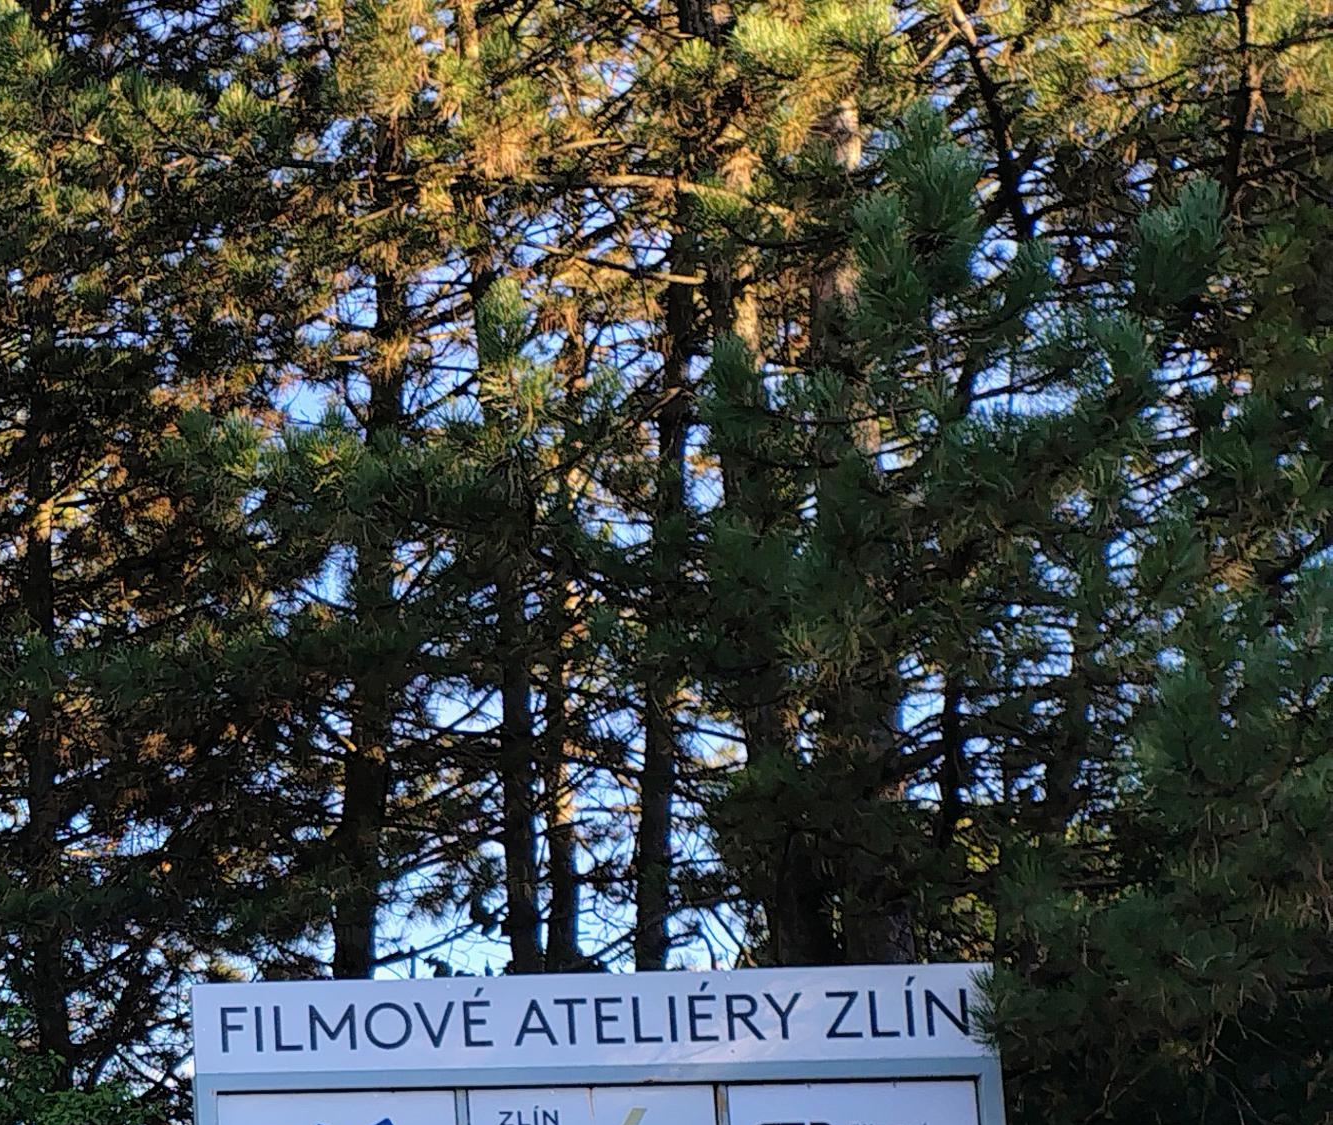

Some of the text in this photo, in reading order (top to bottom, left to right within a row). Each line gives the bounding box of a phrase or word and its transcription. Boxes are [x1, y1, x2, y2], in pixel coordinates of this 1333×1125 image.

[221, 976, 971, 1053] FILMOVÉ ATELIÉRY ZLÍN
